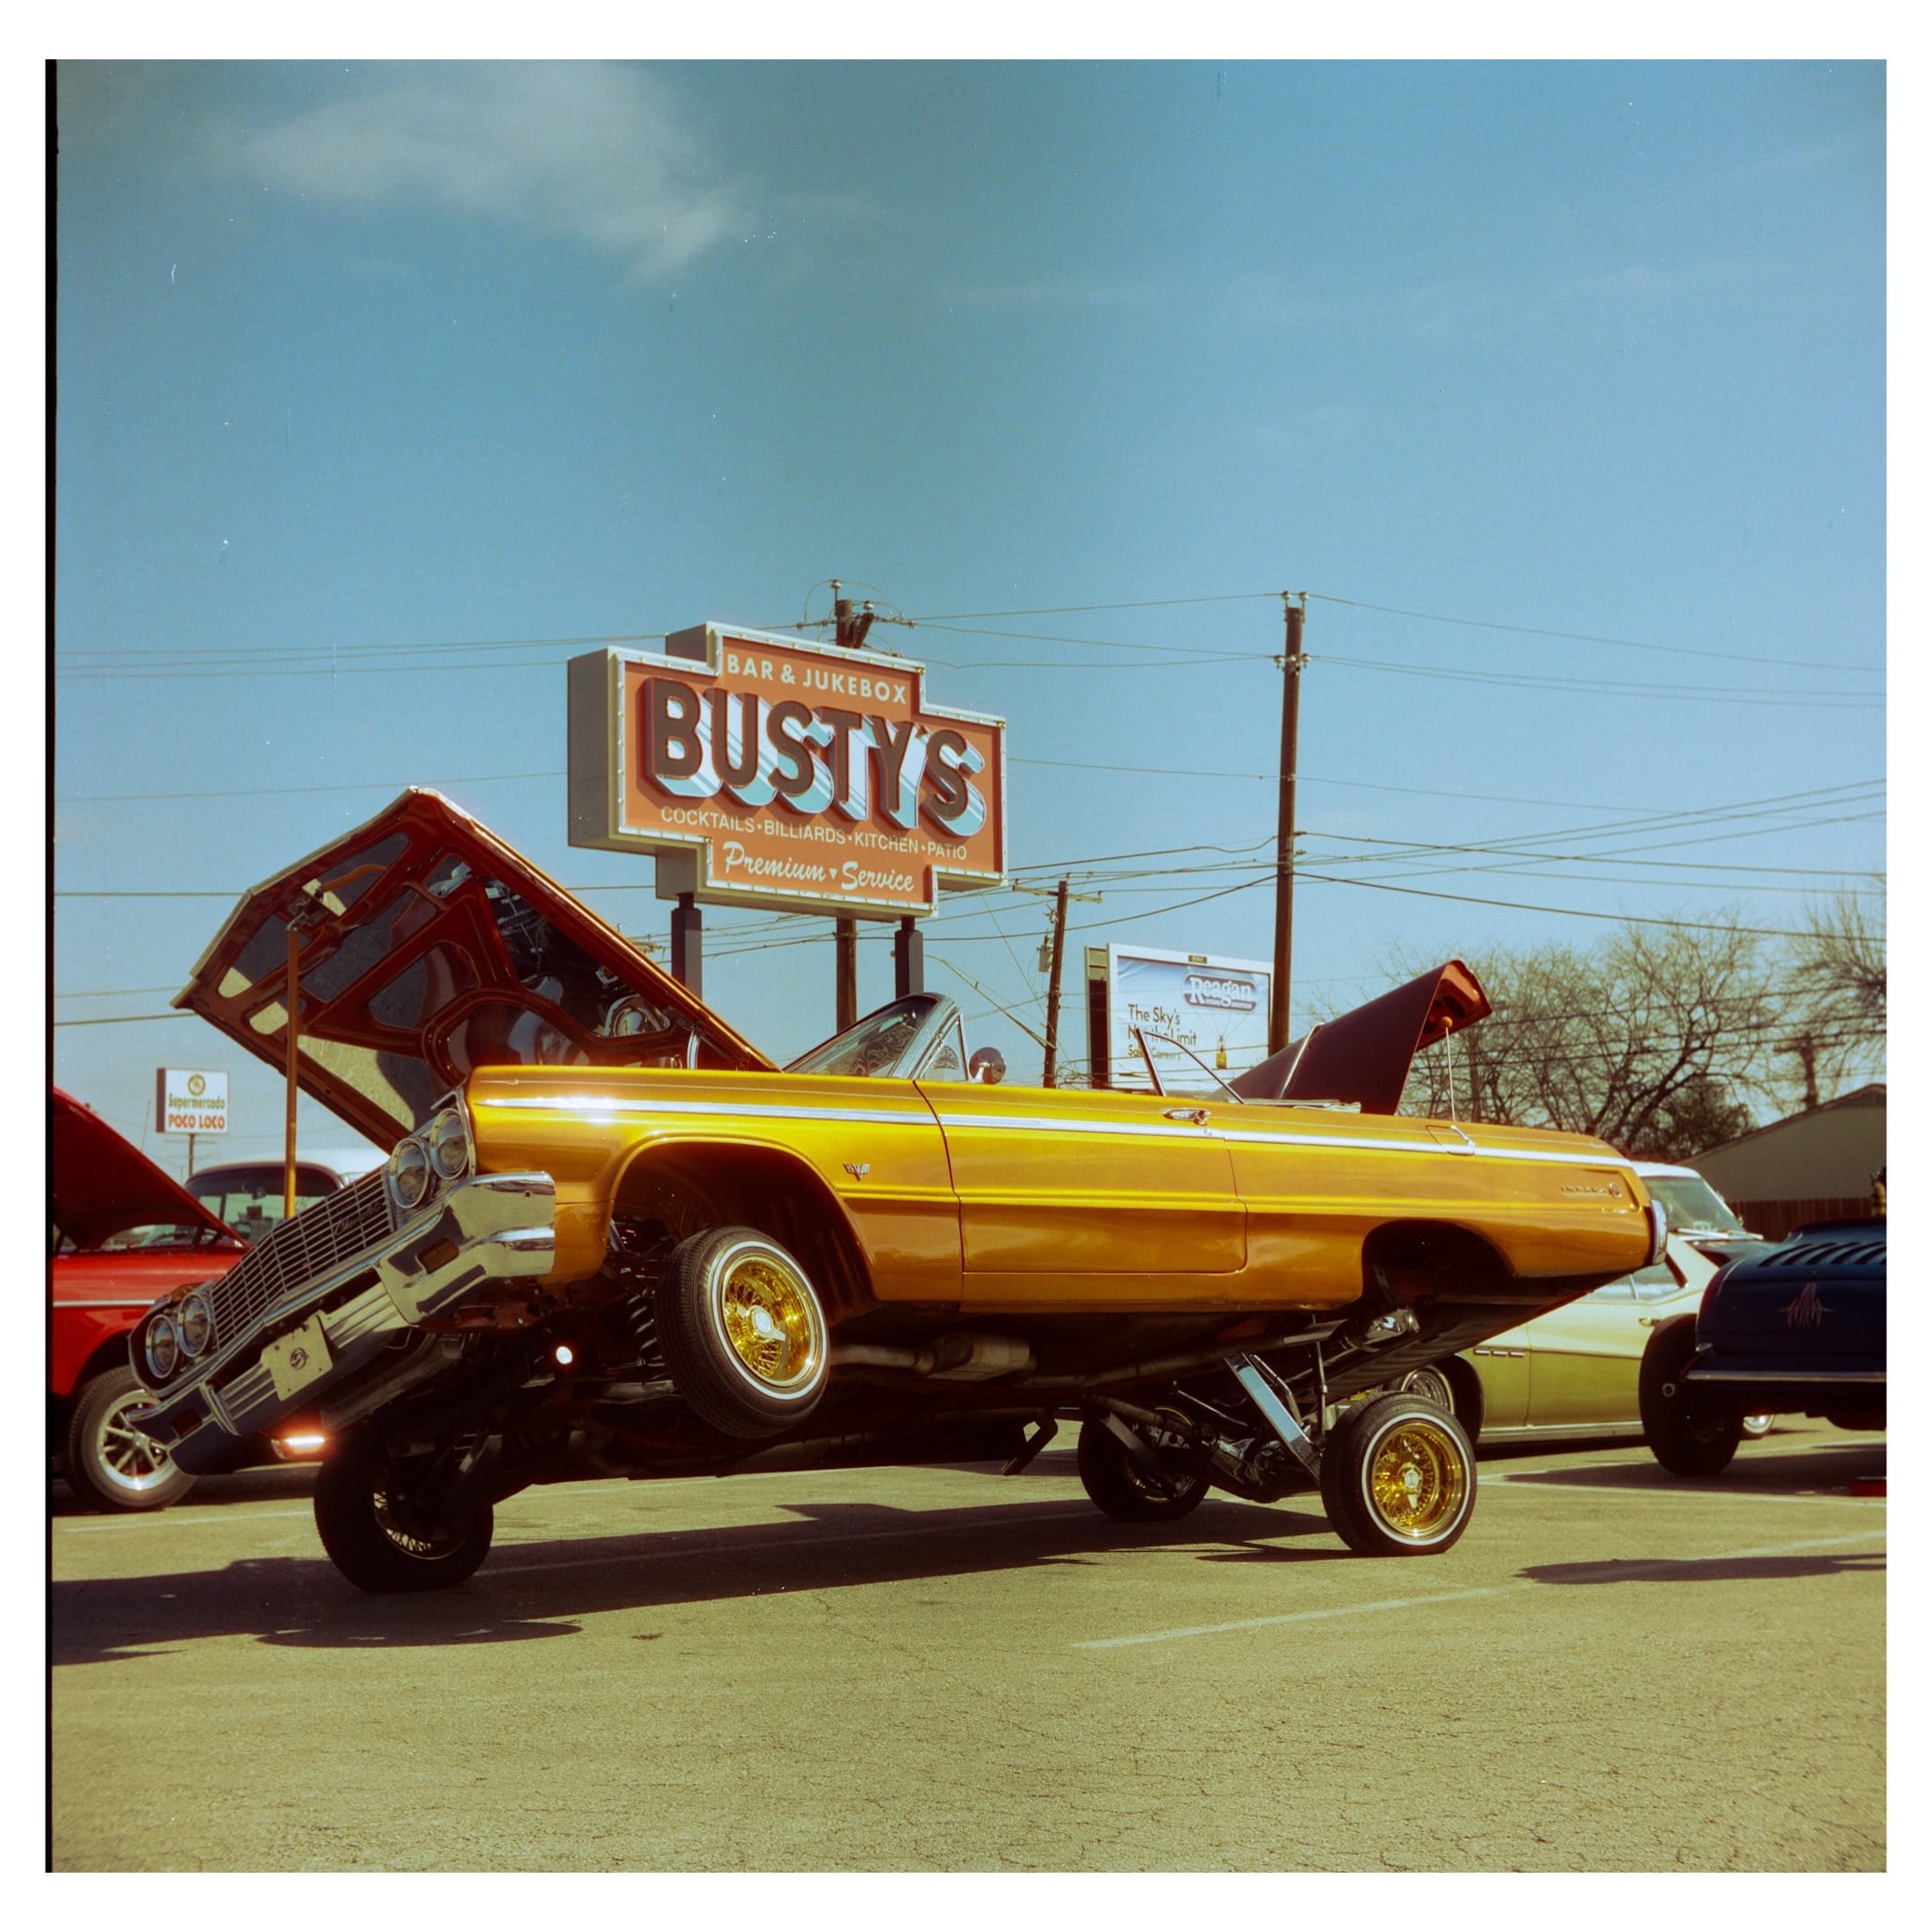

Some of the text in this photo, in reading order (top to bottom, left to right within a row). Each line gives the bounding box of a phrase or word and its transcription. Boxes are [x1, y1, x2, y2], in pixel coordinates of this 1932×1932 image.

[726, 653, 907, 705] BAR & JUKEBOX
[644, 678, 987, 836] BUSTY'S
[660, 806, 968, 861] COCKTAILS BILLIARDS KITCHEN PATIO
[722, 841, 915, 892] Premium Service
[1129, 1003, 1181, 1030] The Sky's
[1188, 976, 1254, 1007] Reagan
[168, 1113, 226, 1130] POCO LOCO
